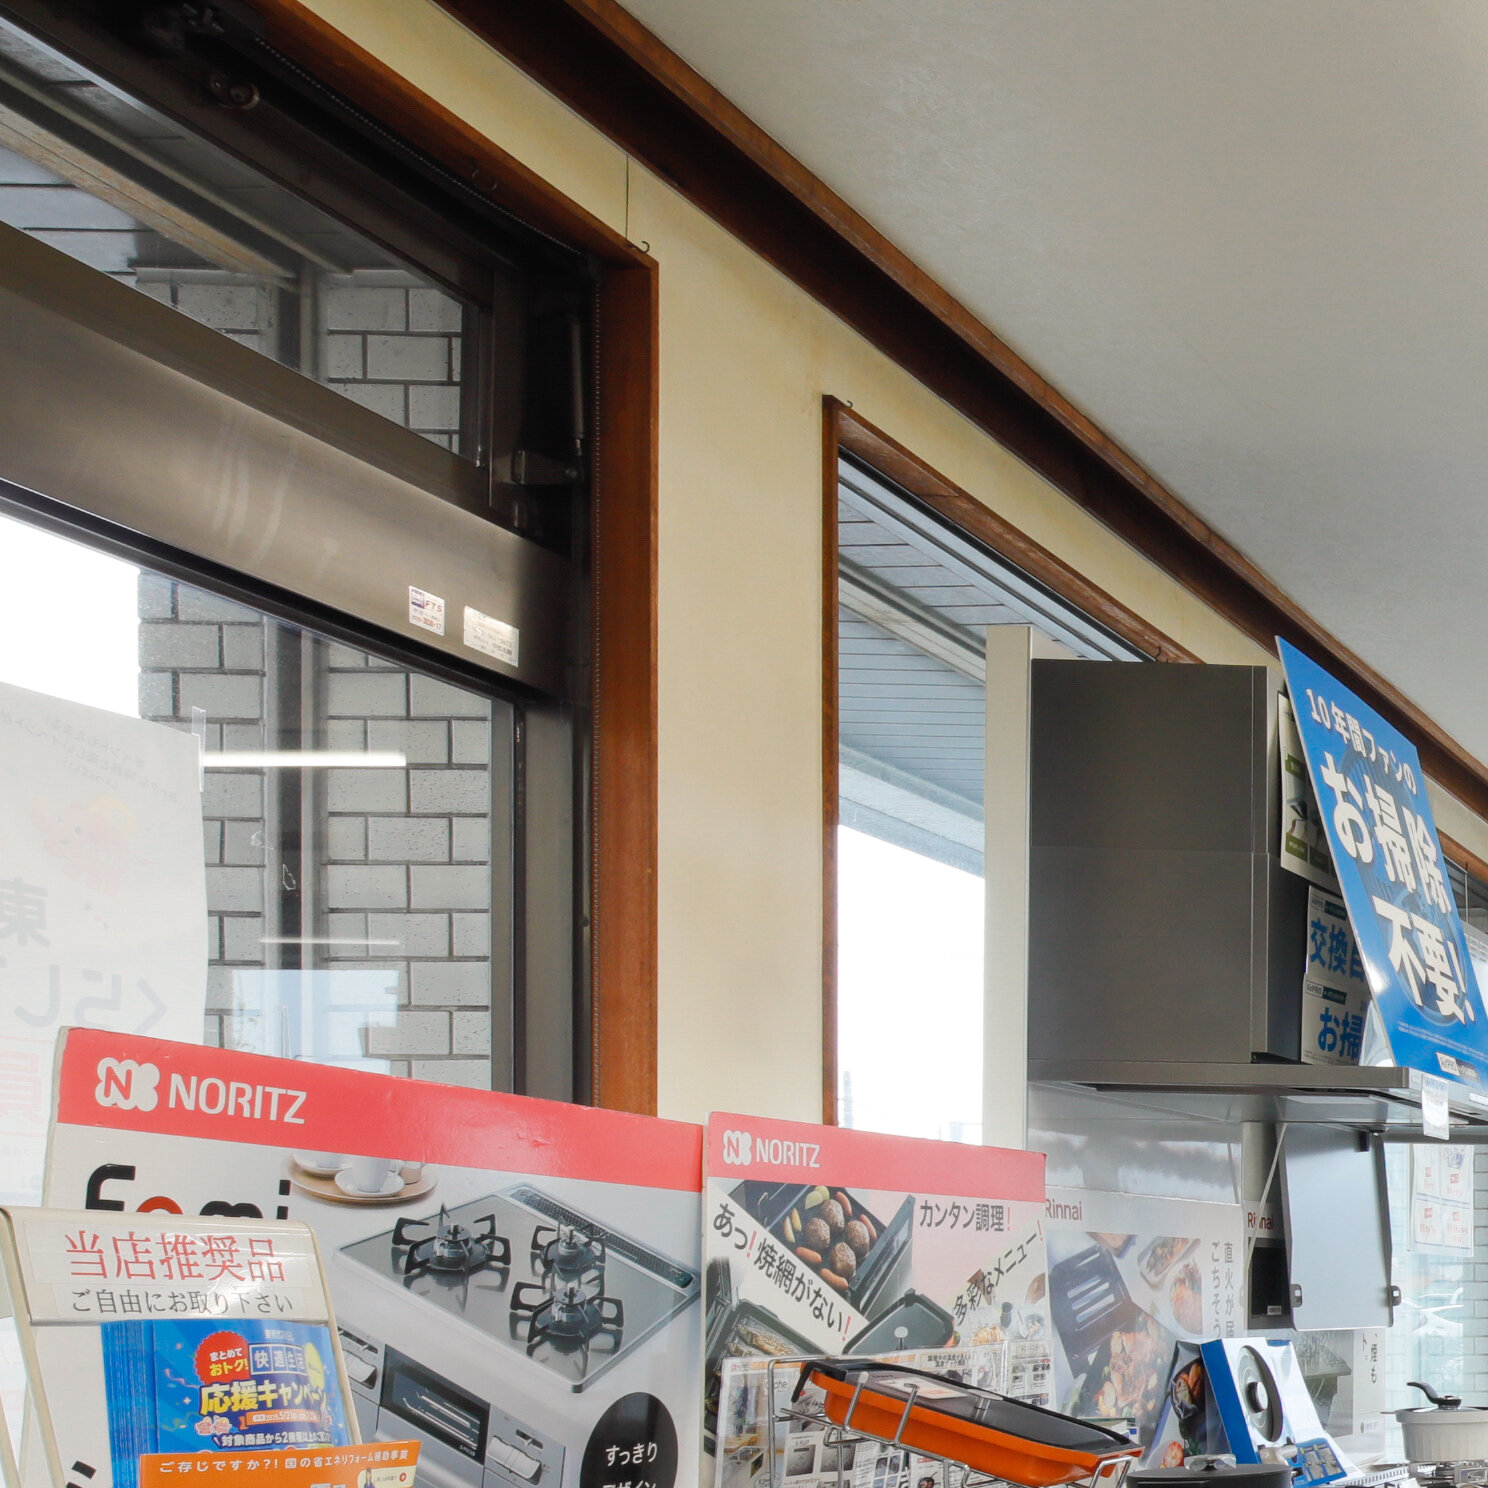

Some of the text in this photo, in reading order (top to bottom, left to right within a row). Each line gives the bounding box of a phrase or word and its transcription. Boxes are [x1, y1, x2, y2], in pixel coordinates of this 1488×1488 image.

[1306, 688, 1418, 796] 10年間ファンの
[1320, 751, 1451, 915] お掃除
[1372, 895, 1476, 1027] 不要!
[168, 1072, 308, 1124] NORITZ
[756, 1138, 821, 1168] NORITZ
[919, 1199, 1011, 1232] カンタン調理!
[1045, 1201, 1083, 1221] Rinnai
[65, 1230, 286, 1283] 当店推奨品
[953, 1218, 1044, 1328] 多彩なメニュー!
[72, 1288, 293, 1315] ご自由にお取り下さい
[210, 1347, 243, 1362] まとめて
[210, 1360, 249, 1377] おトク!
[605, 1441, 658, 1467] すっきり
